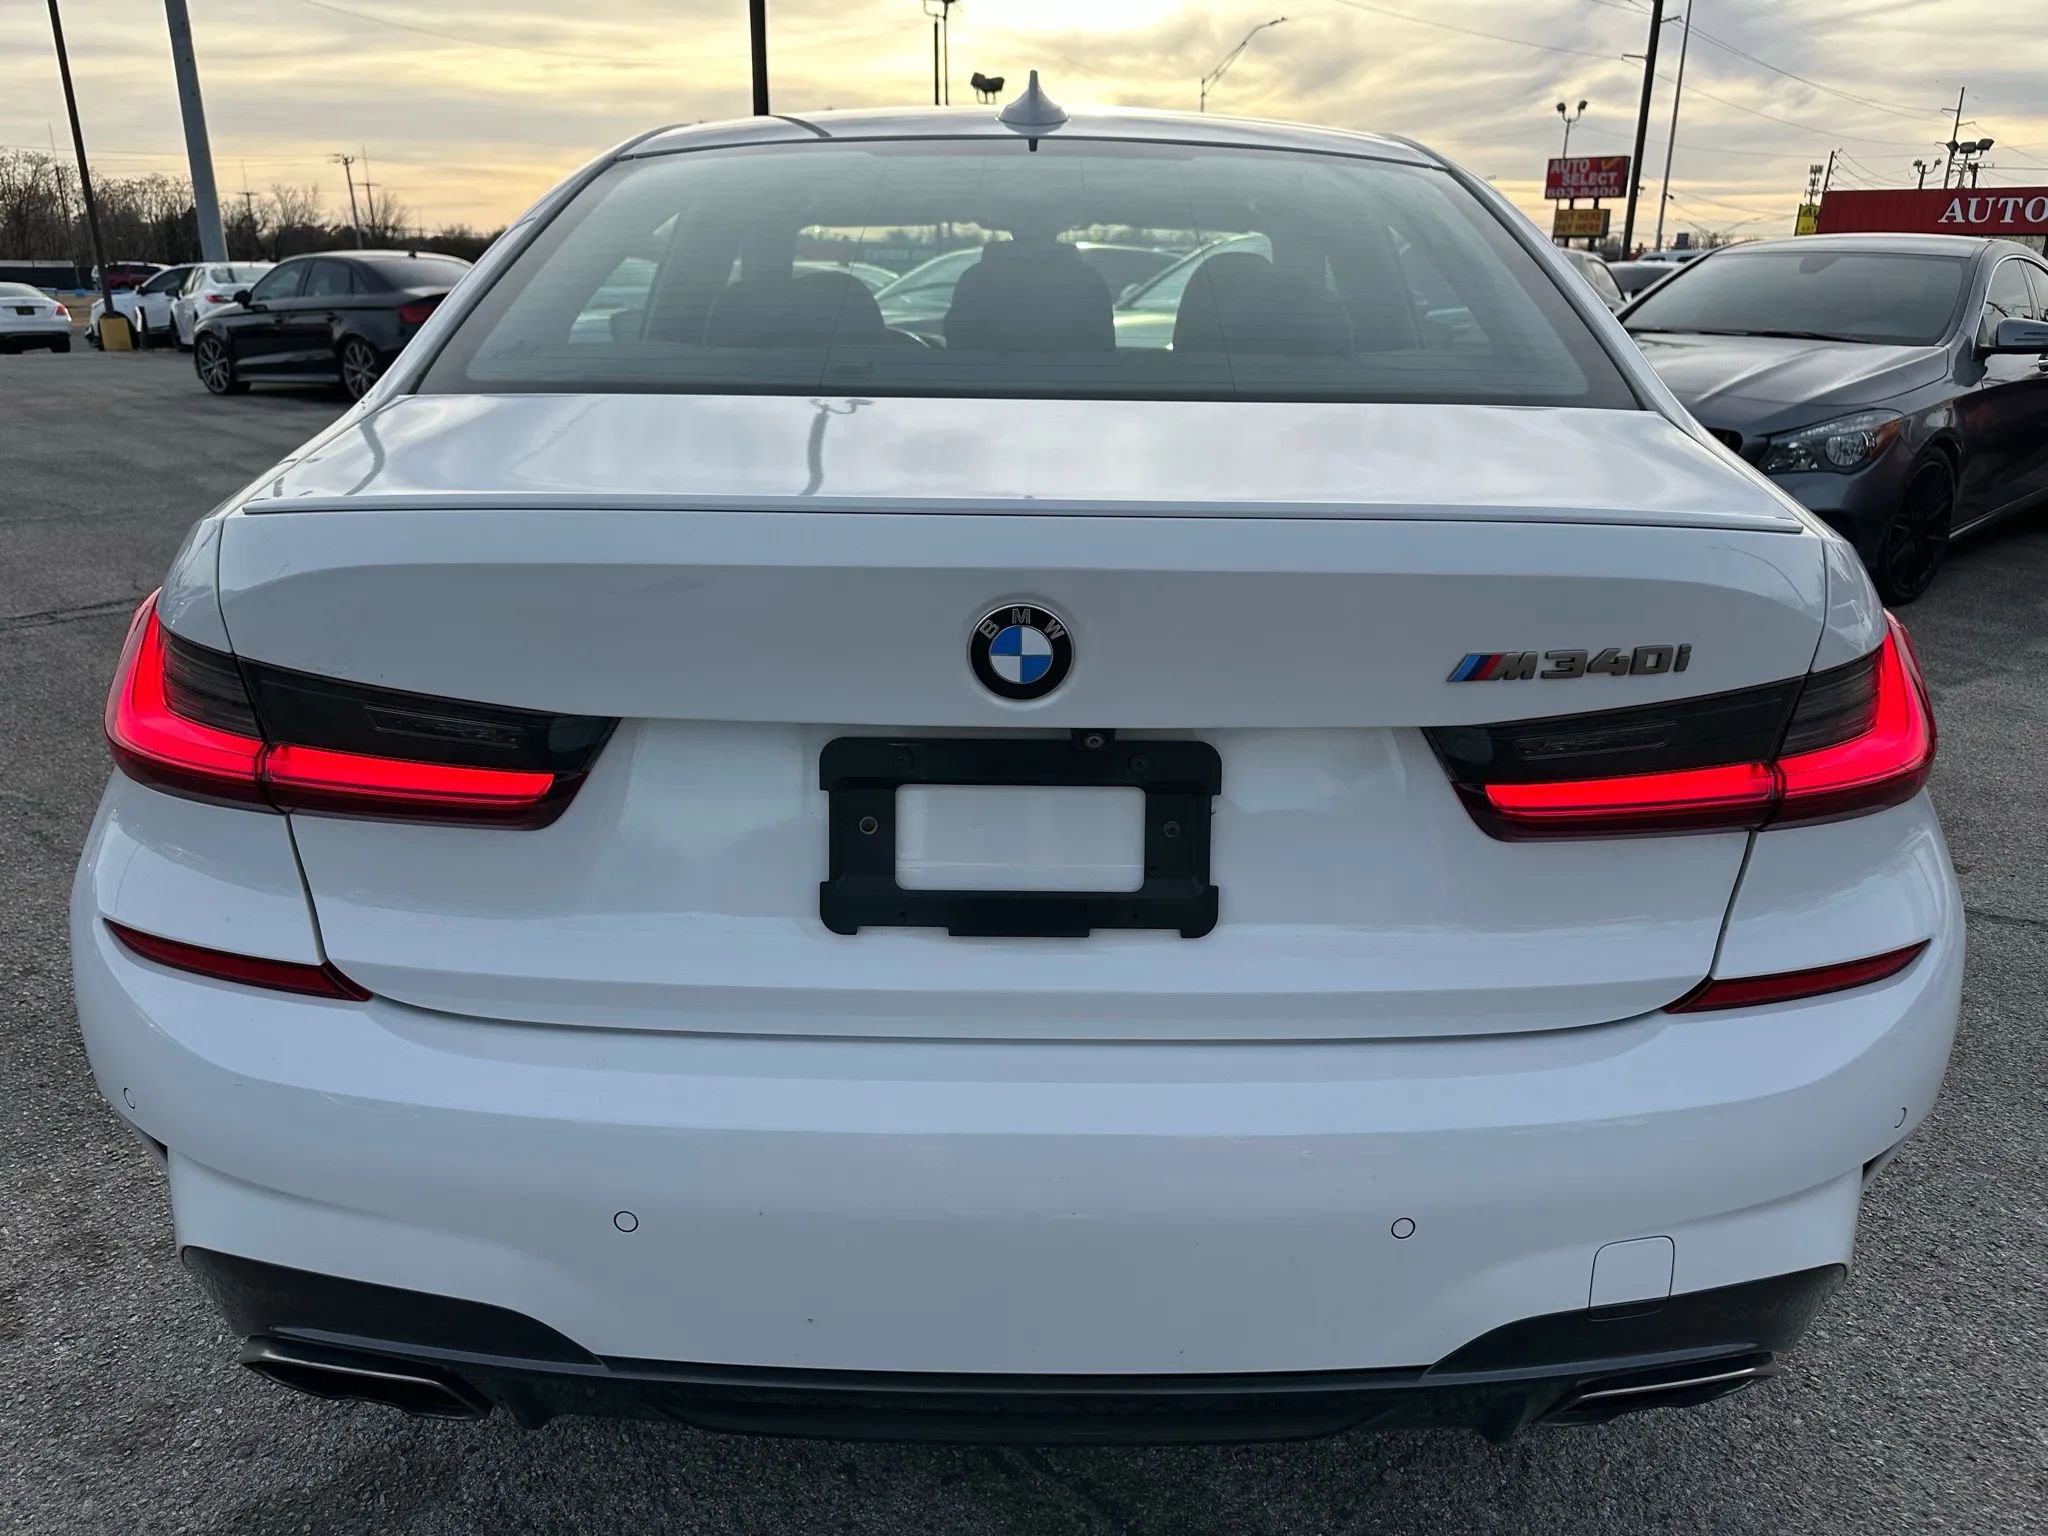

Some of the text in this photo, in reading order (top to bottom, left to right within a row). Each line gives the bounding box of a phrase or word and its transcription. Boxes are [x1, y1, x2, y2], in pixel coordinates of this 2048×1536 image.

[1550, 159, 1590, 173] AUTO
[1562, 172, 1617, 186] SELECT
[1938, 196, 2048, 223] AUTO
[979, 608, 1064, 640] BMW
[1484, 643, 1692, 681] M340i
